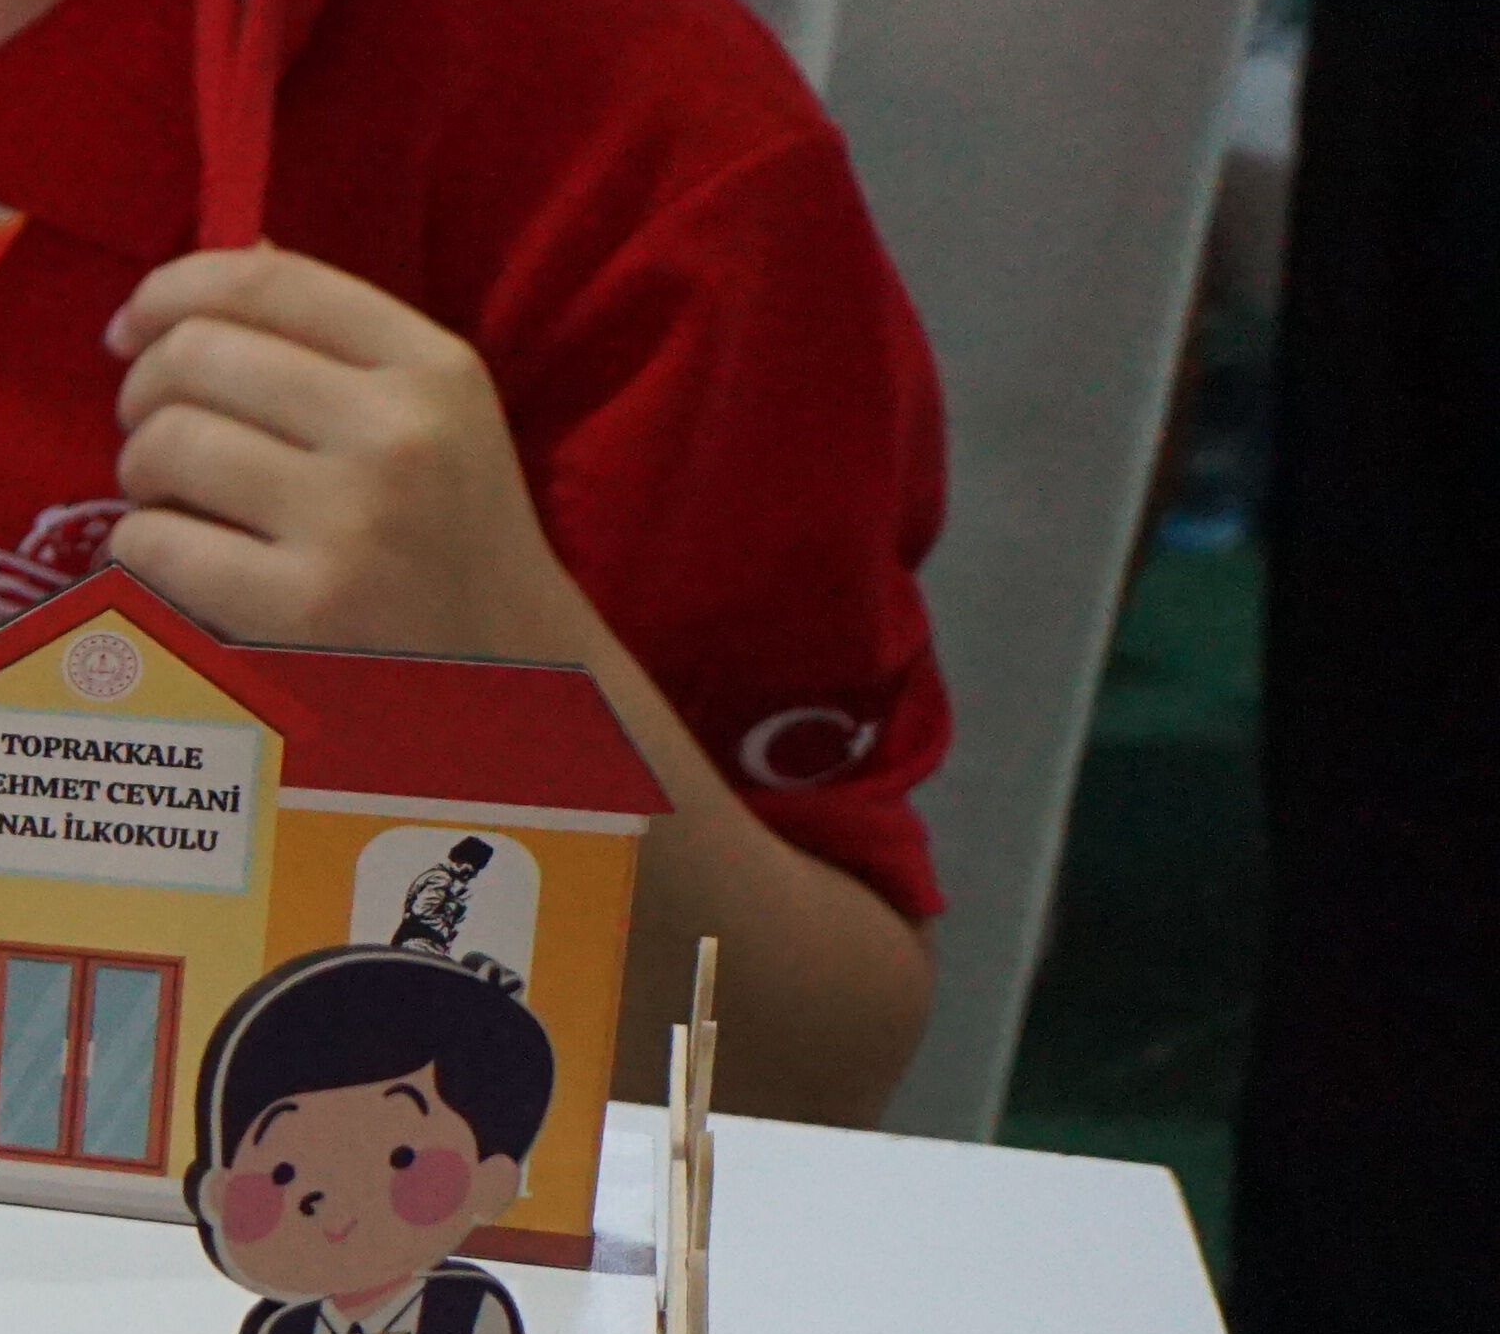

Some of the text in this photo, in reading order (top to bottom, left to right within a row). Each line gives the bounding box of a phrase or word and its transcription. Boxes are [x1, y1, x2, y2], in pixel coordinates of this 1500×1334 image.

[1, 733, 203, 770] TOPRAKKALE
[106, 781, 240, 813] CEVLANİ
[64, 812, 218, 851] İLKOKULU
